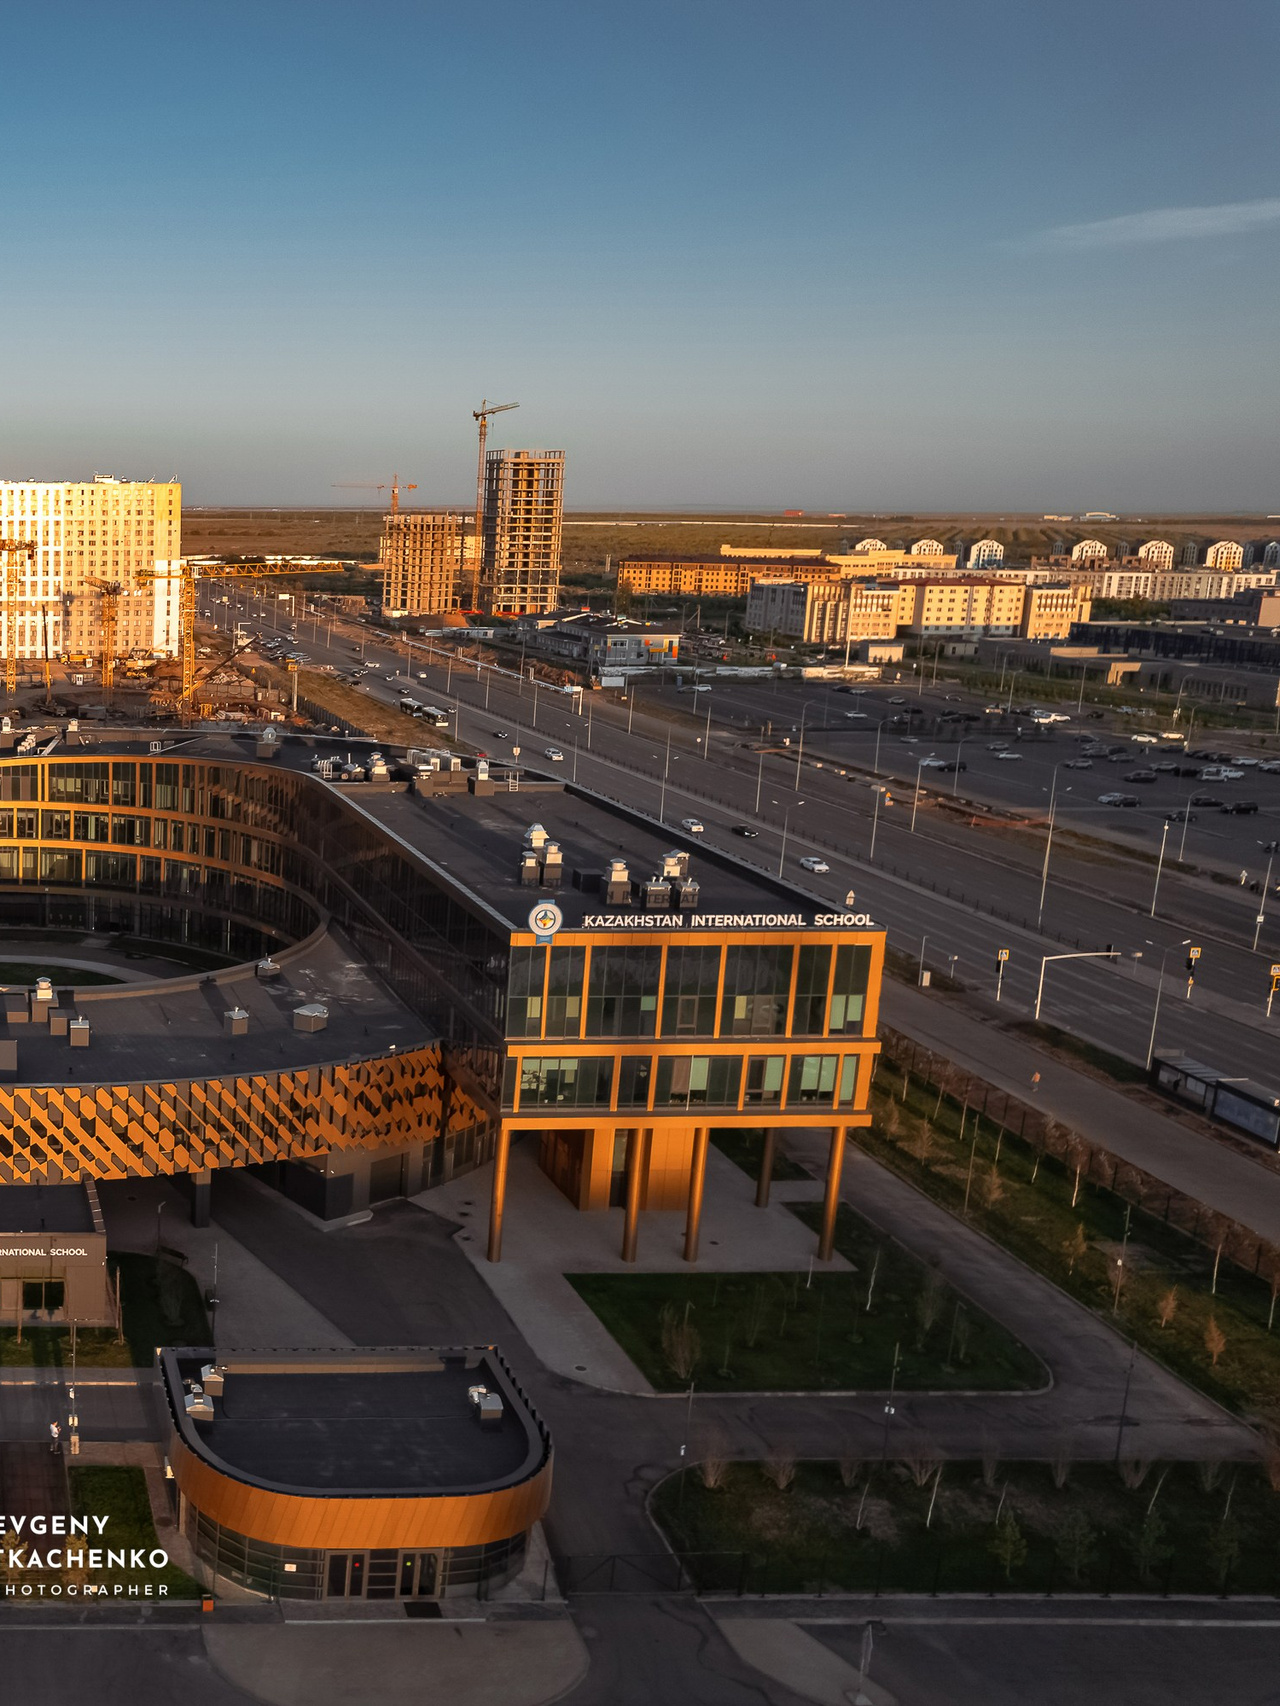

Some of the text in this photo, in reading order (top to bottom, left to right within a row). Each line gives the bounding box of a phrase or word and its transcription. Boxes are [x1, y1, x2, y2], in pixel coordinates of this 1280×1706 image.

[584, 913, 875, 929] KAZAKHSTAN INTERNATIONAL SCHOOL
[49, 1248, 88, 1257] SCHOOL
